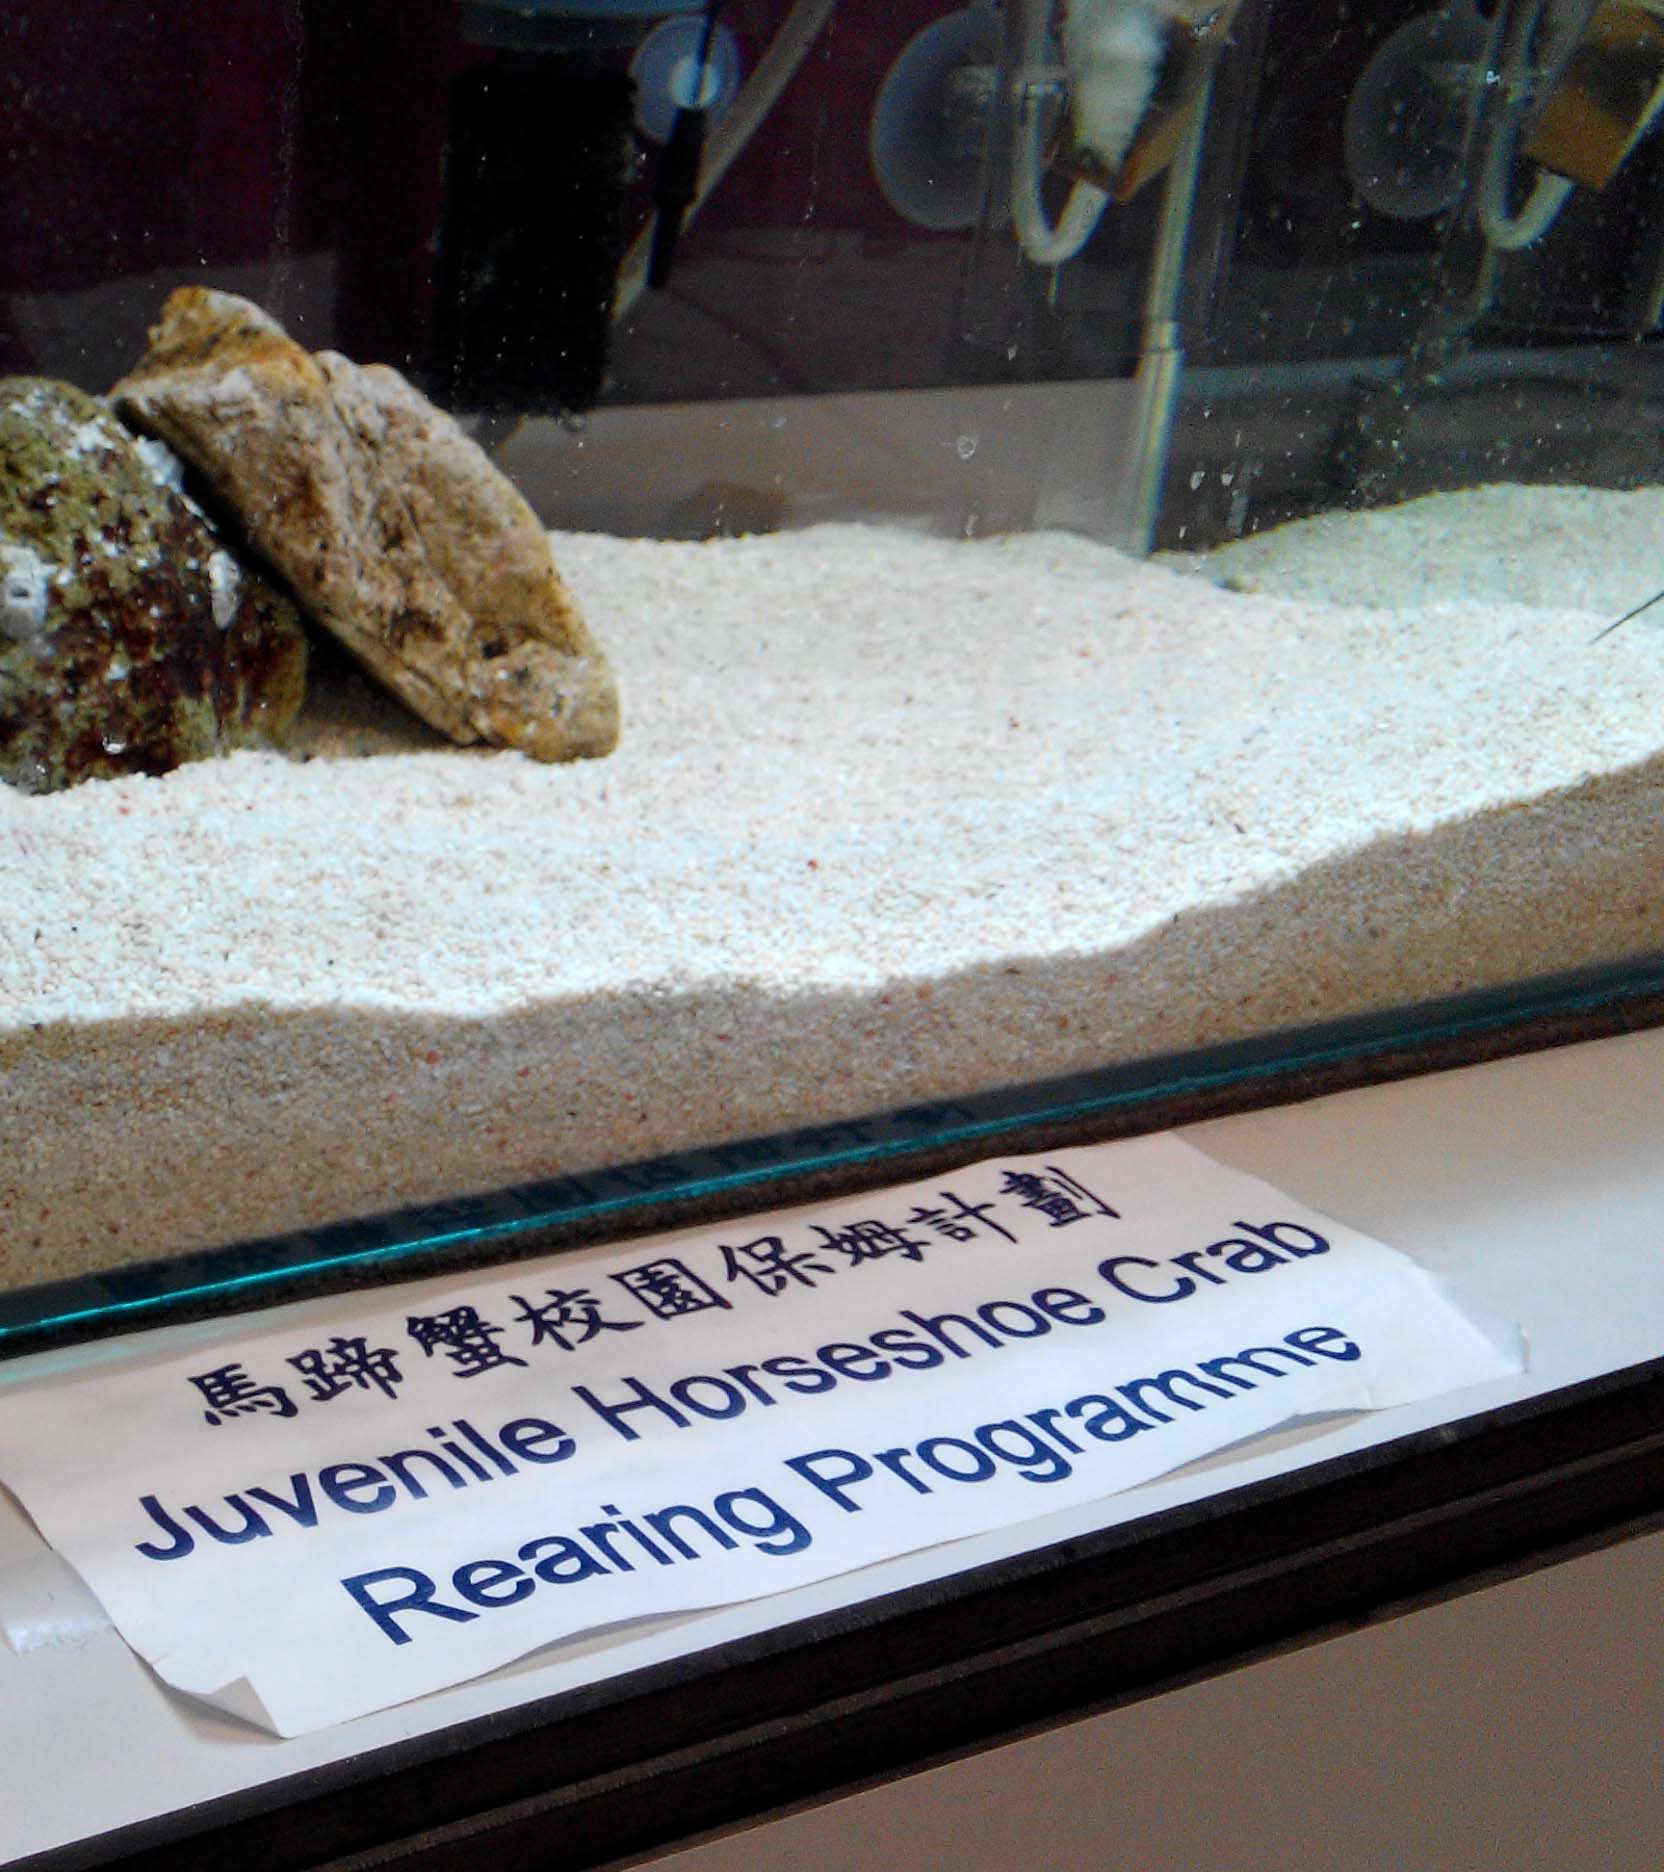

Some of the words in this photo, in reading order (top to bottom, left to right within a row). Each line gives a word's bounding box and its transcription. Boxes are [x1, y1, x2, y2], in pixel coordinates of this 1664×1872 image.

[135, 1418, 576, 1561] Juvenile
[570, 1287, 1106, 1441] Horseshoe
[1097, 1220, 1330, 1304] Crab
[187, 1166, 1121, 1426] 馬蹄蟹校園保姆計劃
[341, 1487, 812, 1645] Rearing
[784, 1326, 1361, 1512] Programme
